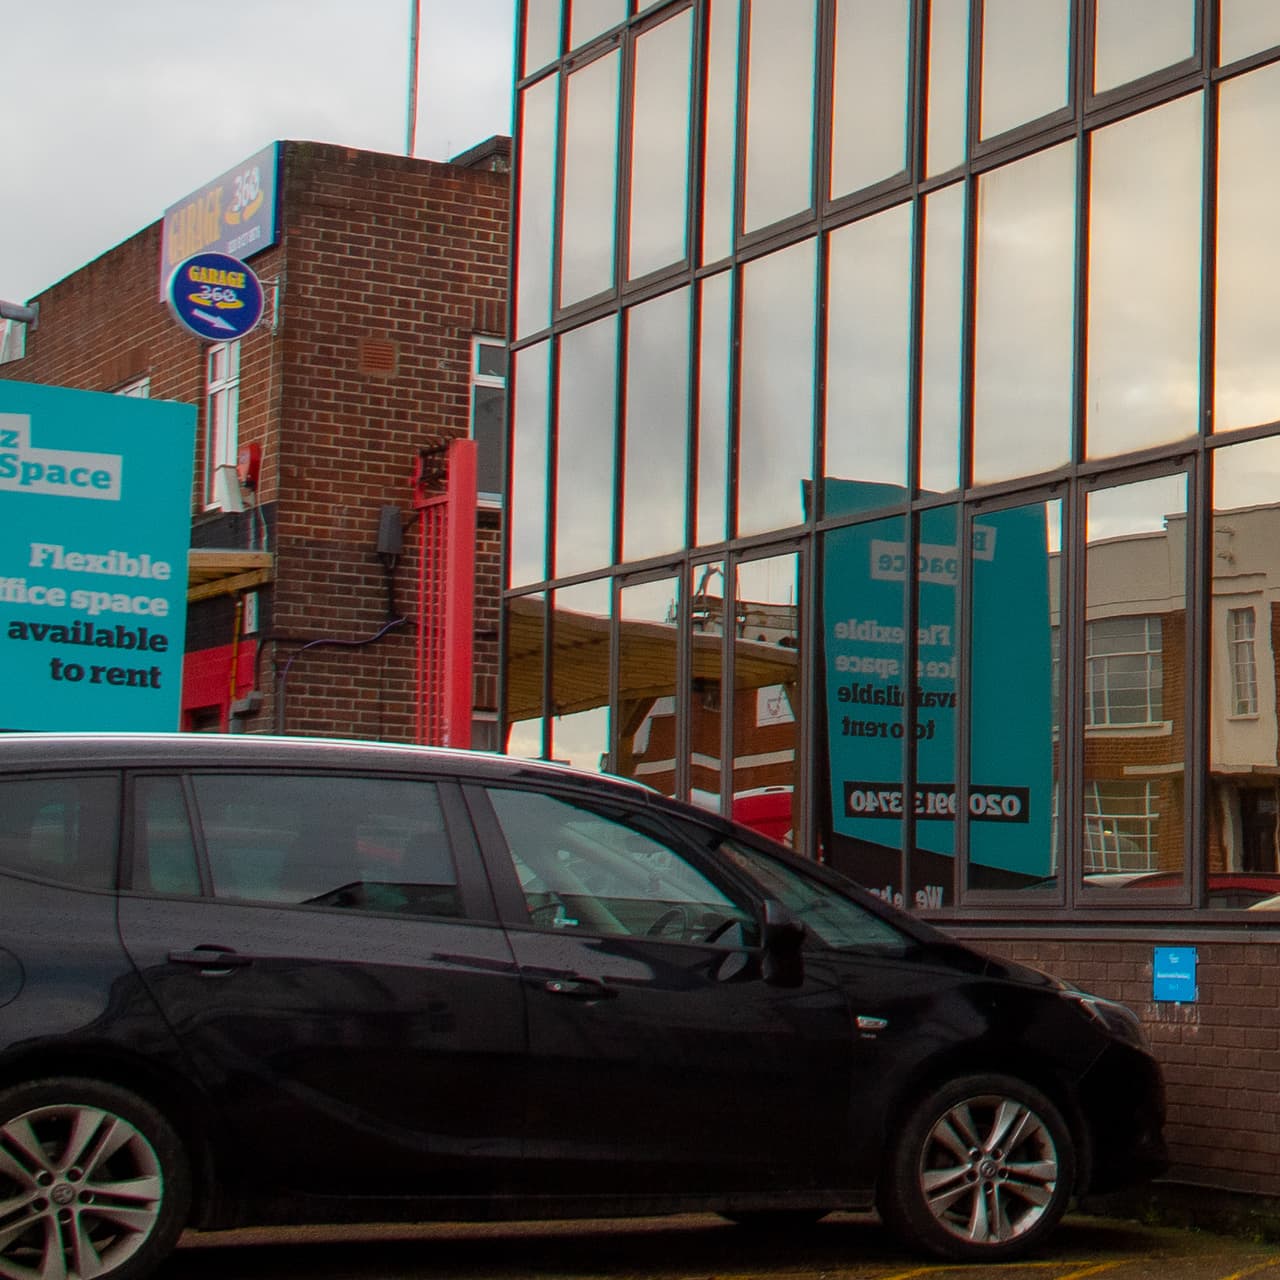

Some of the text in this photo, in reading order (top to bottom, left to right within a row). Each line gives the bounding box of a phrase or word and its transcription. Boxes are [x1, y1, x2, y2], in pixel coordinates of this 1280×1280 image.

[188, 265, 246, 289] GARAGE
[200, 284, 237, 303] 360
[0, 453, 112, 490] Space
[28, 542, 171, 581] Flexible
[0, 576, 169, 617] ffice space
[8, 619, 169, 653] available
[49, 657, 163, 689] to rent
